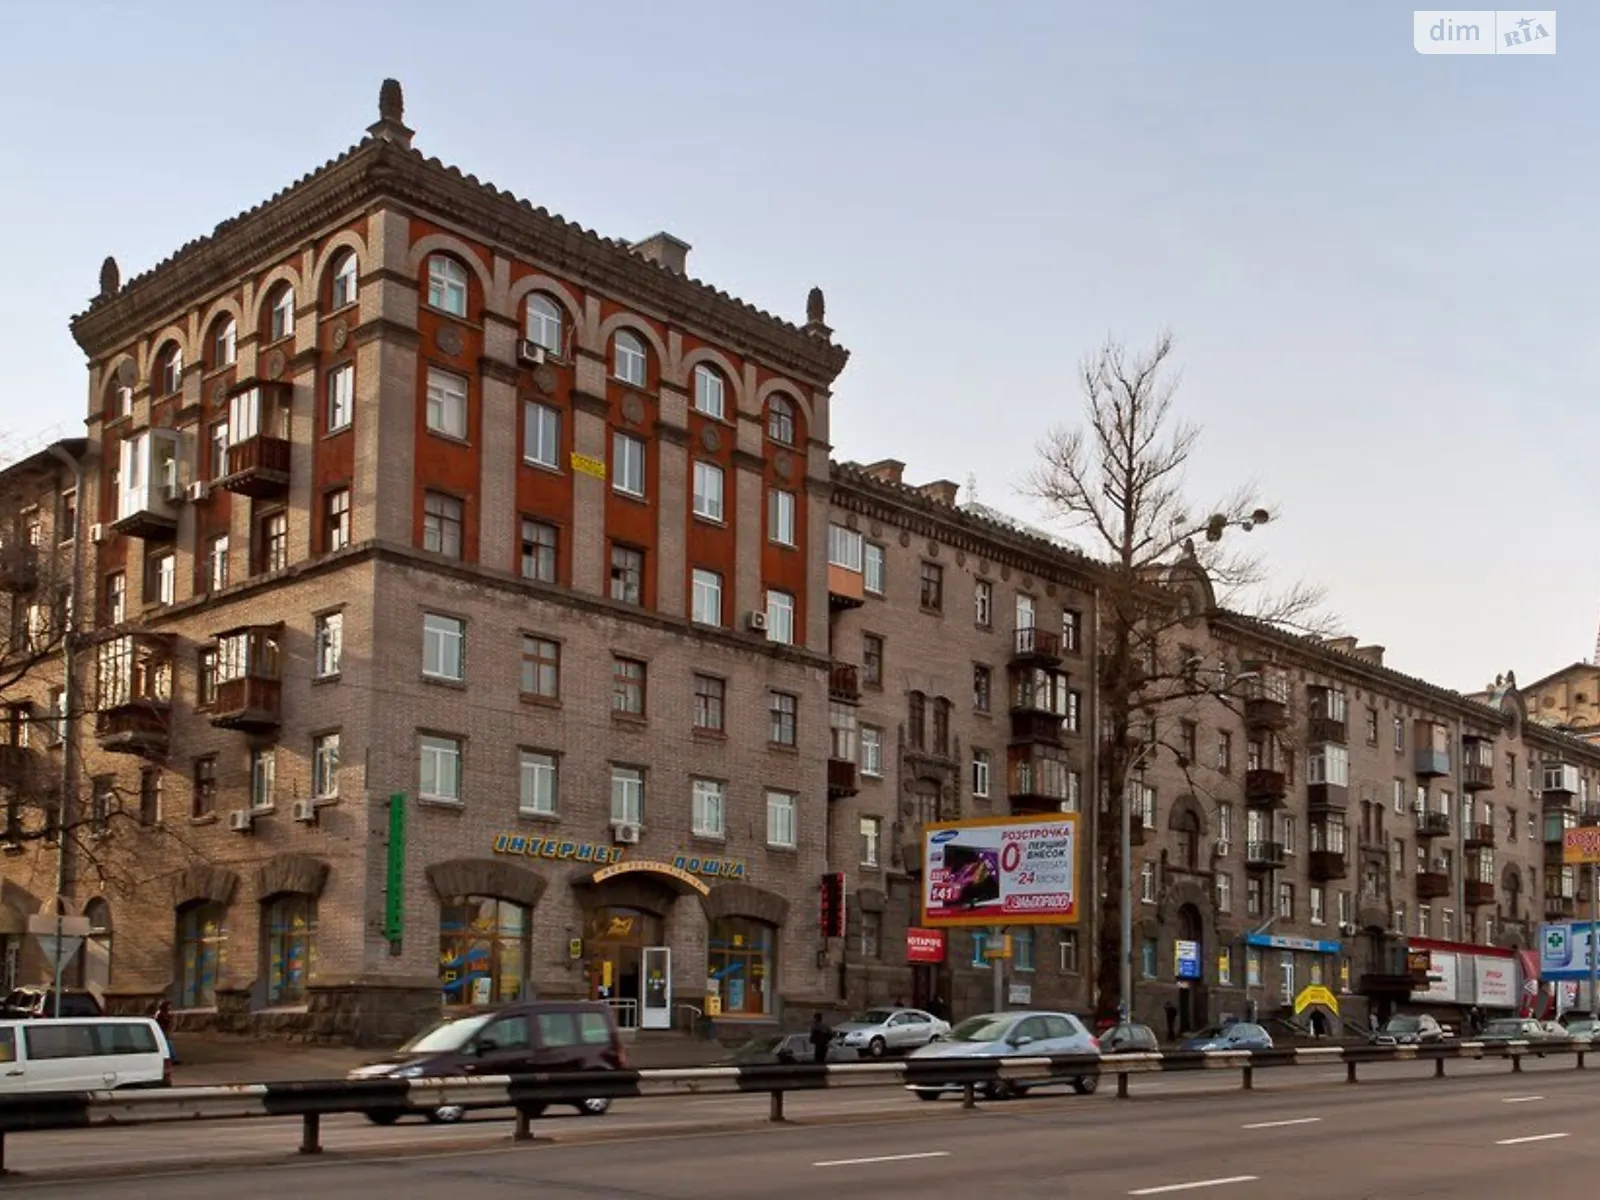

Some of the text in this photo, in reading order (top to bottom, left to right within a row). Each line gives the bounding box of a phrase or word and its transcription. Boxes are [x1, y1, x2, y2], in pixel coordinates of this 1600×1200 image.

[1001, 827, 1069, 840] РОЗСТРОЧКА
[493, 834, 623, 863] ІНТЕРНЕТ
[673, 855, 745, 877] ПОШТА
[1019, 872, 1035, 885] 24
